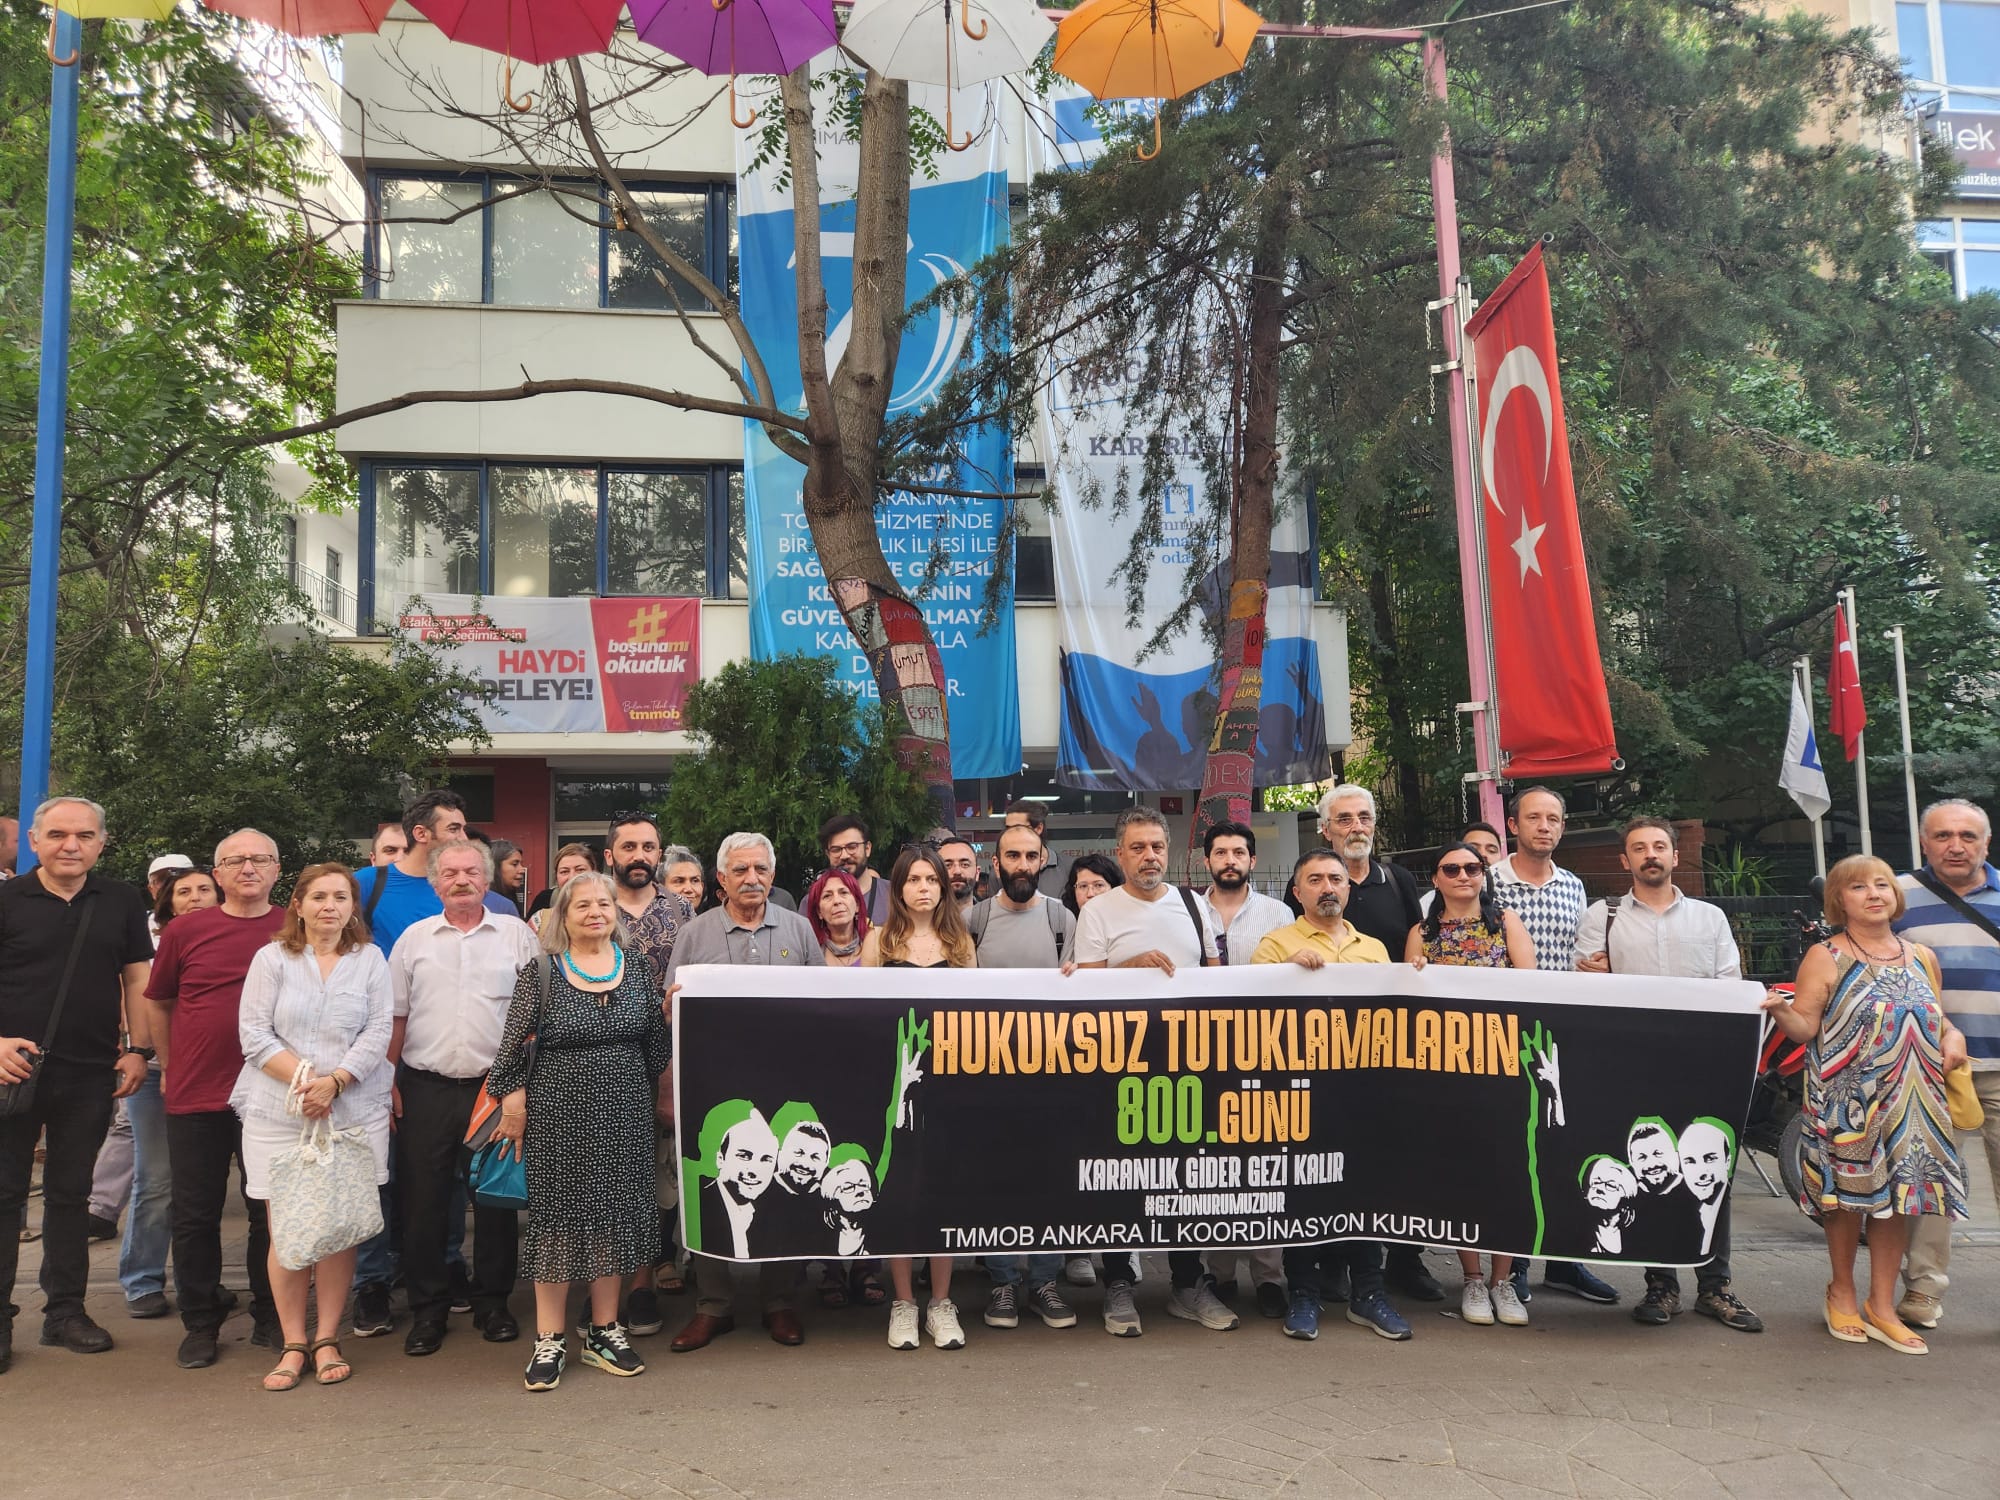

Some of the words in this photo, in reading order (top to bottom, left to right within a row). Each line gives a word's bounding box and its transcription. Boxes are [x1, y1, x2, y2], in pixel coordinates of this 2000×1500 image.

[605, 655, 687, 674] okuduk
[894, 652, 925, 669] UMUT
[629, 708, 681, 720] tmmob
[933, 1010, 1149, 1075] HUKUKSUZ
[1161, 1008, 1520, 1077] TUTUKLAMALARIN
[1078, 1157, 1180, 1191] KARANLIK
[1185, 1148, 1241, 1189] GİDER
[1247, 1146, 1288, 1187] GEZİ
[1294, 1152, 1344, 1186] KALIR
[940, 1225, 1036, 1248] TMMOB
[1040, 1223, 1144, 1246] ANKARA
[1151, 1219, 1170, 1243] İL
[1177, 1212, 1365, 1243] KOORDİNASYON
[1373, 1212, 1480, 1244] KURULU
